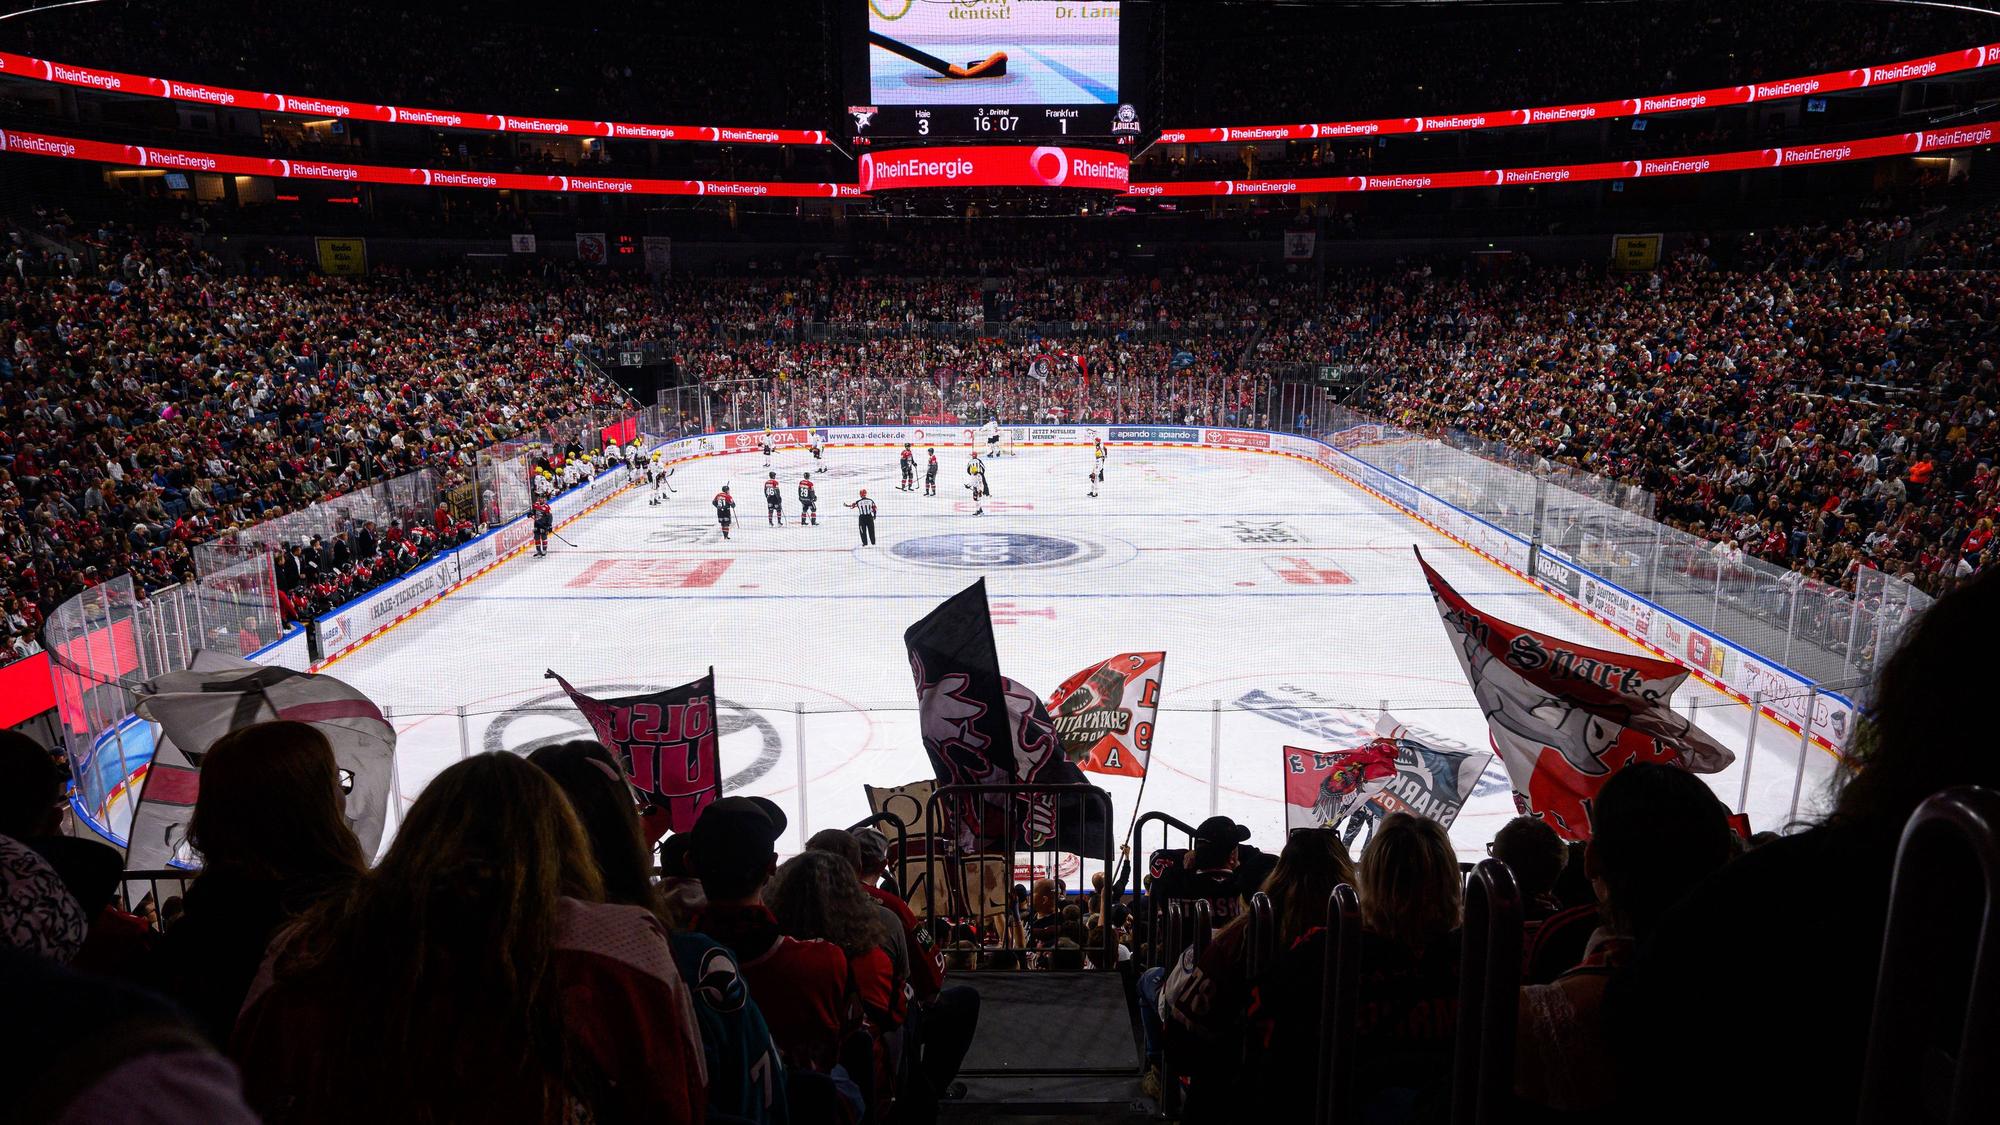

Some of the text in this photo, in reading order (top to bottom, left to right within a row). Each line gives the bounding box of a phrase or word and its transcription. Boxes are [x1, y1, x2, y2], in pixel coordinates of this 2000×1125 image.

[949, 5, 1010, 19] dentist!
[1056, 6, 1076, 18] Dr.
[55, 67, 120, 88] RheinEnergie
[1874, 61, 1936, 81] RheinEnergie
[173, 85, 234, 104] RheinEnergie
[1758, 80, 1819, 97] RheinEnergie
[288, 99, 349, 116] RheinEnergie
[1644, 95, 1705, 110] RheinEnergie
[399, 111, 461, 126] RheinEnergie
[915, 110, 930, 118] Haie
[1046, 109, 1078, 118] Frankfurt
[1533, 107, 1595, 120] RheinEnergie
[508, 119, 568, 133] RheinEnergie
[918, 119, 929, 134] 3
[974, 117, 1018, 131] 16:07
[1060, 119, 1067, 134] 1
[1321, 124, 1378, 137] RheinEnergie
[1426, 117, 1485, 131] RheinEnergie
[616, 125, 674, 138] RheinEnergie
[722, 130, 778, 142] RheinEnergie
[1231, 129, 1288, 140] RheinEnergie
[1926, 128, 1991, 148] RheinEnergie
[9, 135, 74, 156] RheinEnergie
[1785, 146, 1850, 161] RheinEnergie
[150, 152, 215, 170] RheinEnergie
[877, 158, 973, 178] RheinEnergie
[1645, 161, 1709, 172] RheinEnergie
[293, 164, 357, 179] RheinEnergie
[1507, 170, 1569, 181] RheinEnergie
[434, 173, 496, 187] RheinEnergie
[571, 180, 632, 192] RheinEnergie
[1370, 177, 1430, 187] RheinEnergie
[707, 184, 766, 195] RheinEnergie
[1236, 183, 1296, 192] RheinEnergie
[830, 430, 906, 440] www.axa-decker.de
[800, 489, 808, 497] 29
[1596, 586, 1630, 610] DEUTSCHLAND
